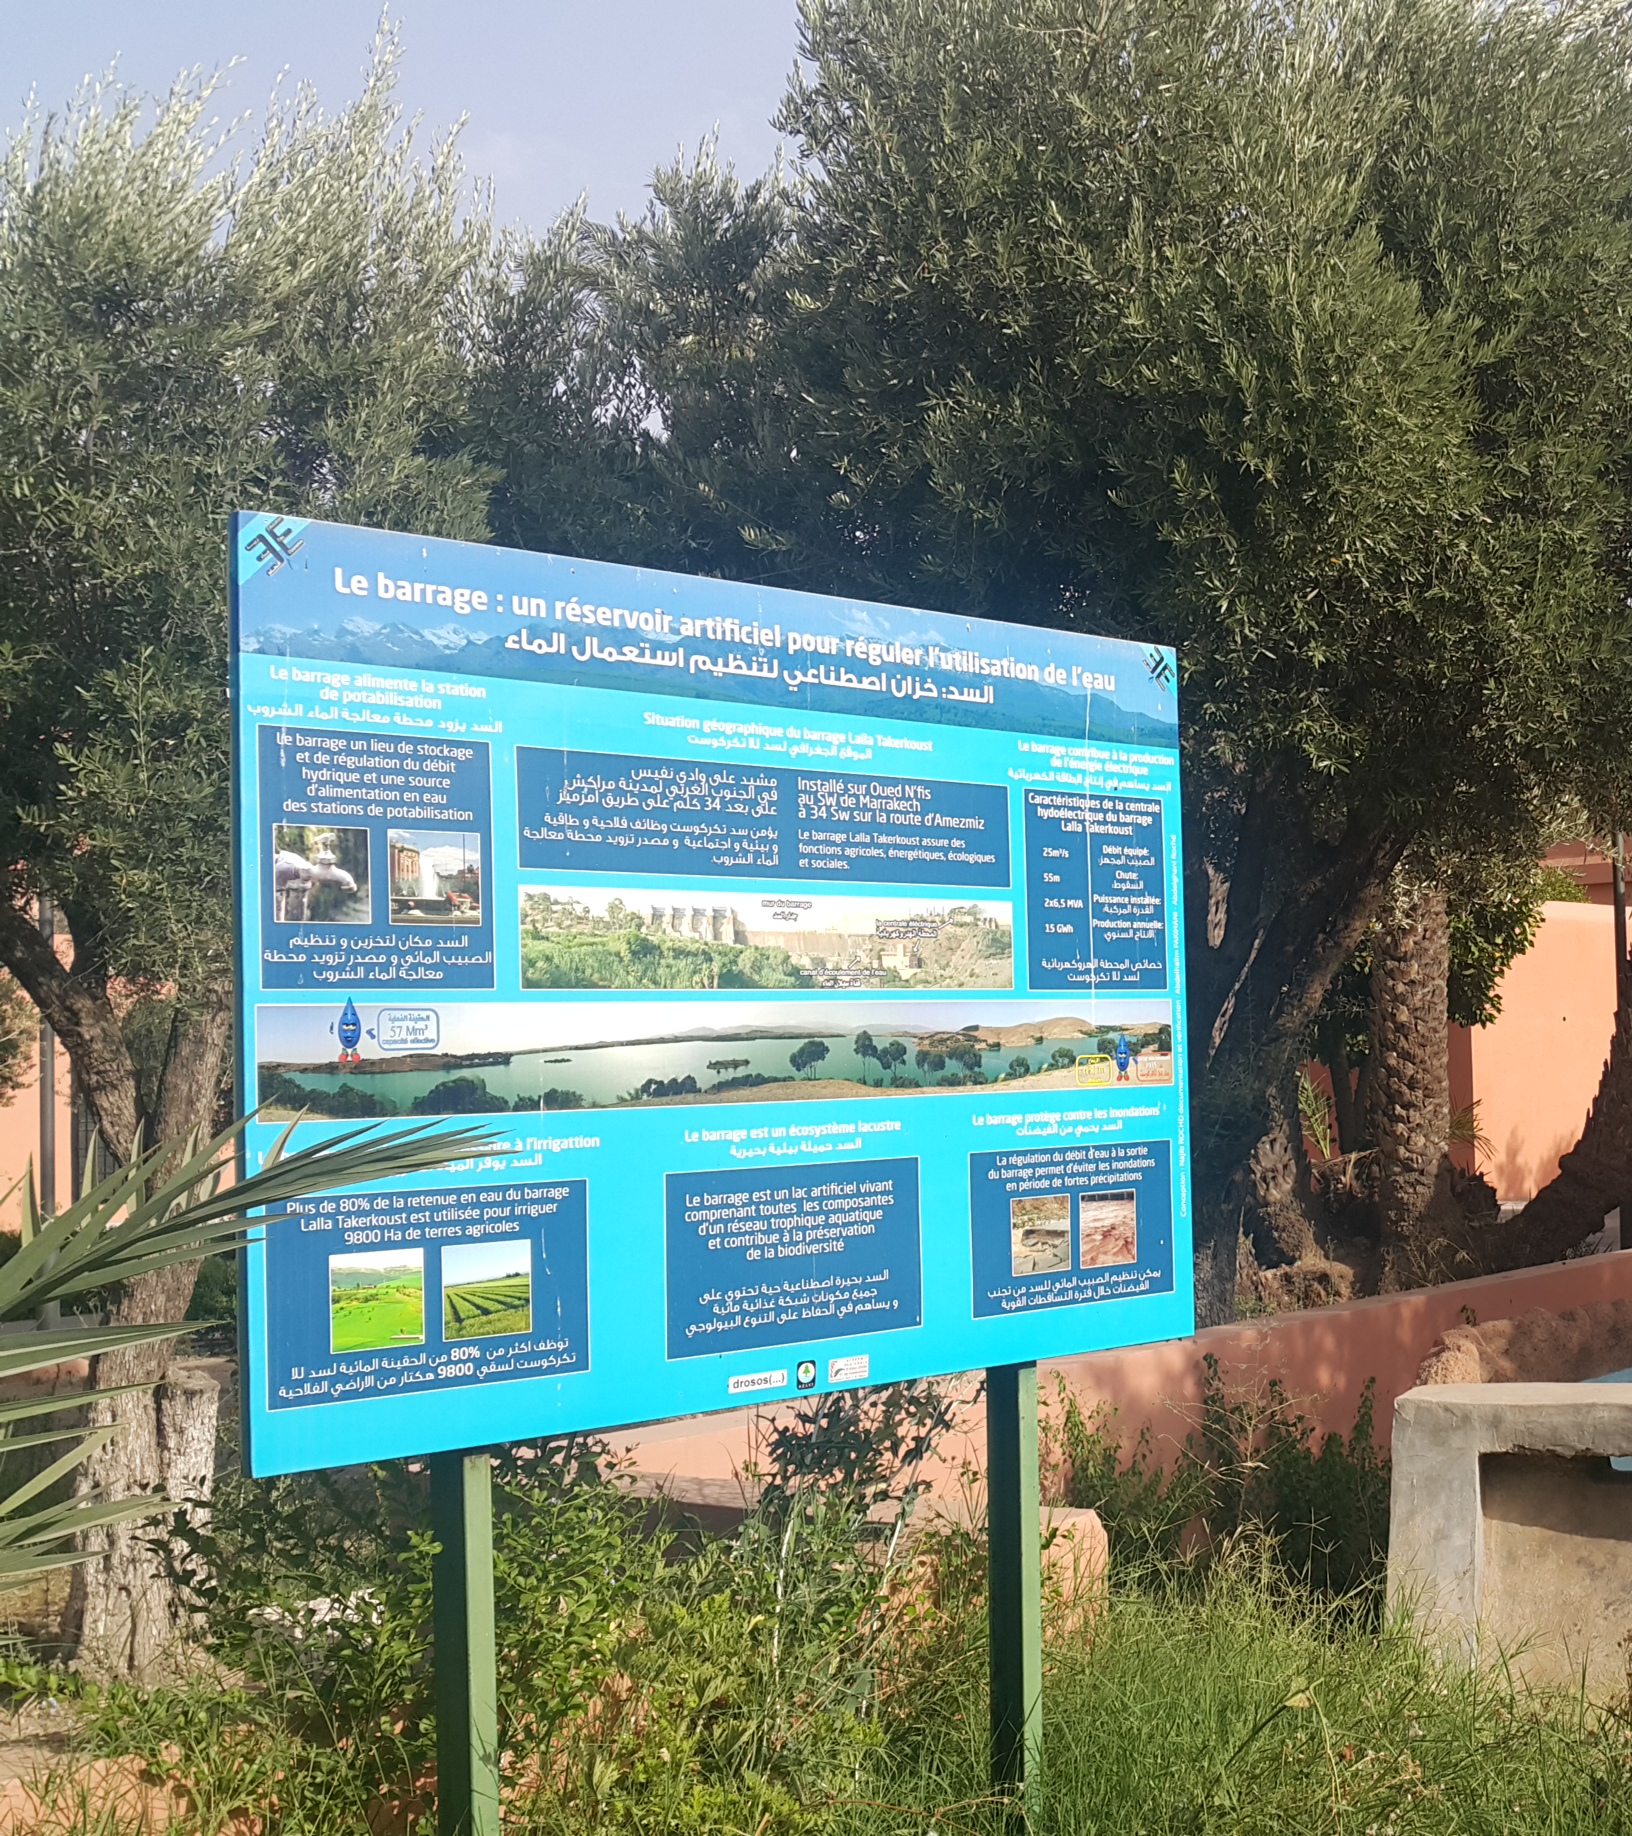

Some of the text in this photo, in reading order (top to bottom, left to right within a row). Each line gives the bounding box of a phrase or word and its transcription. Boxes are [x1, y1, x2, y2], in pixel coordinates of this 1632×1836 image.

[333, 567, 368, 595] Le
[376, 572, 487, 616] barrage
[512, 596, 545, 617] un
[555, 595, 672, 633] réservoir
[679, 613, 780, 647] artificiel
[787, 632, 839, 659] pour
[845, 635, 922, 669] réguler
[928, 646, 1038, 680] l'utilisation
[1043, 662, 1067, 684] de
[1072, 667, 1115, 690] l'eau
[504, 627, 993, 703] السد: خزان اصطناعي لتنظيم استعمال الماء
[270, 665, 487, 699] Le barrage alimente la station
[319, 686, 442, 710] de potabilisation
[644, 712, 933, 752] Situation géographique du barrage Lalla Takerkoust
[276, 731, 474, 761] Le barrage un lieu de stockage
[296, 751, 456, 773] et de régulation du débit
[302, 767, 451, 789] hydrique et une source
[798, 776, 932, 800] Installé sur Oued N'fis
[307, 783, 447, 804] d'alimentation en eau
[798, 792, 921, 812] au SW de Marrakech
[1028, 792, 1161, 814] Caractéristiques de la centrale
[283, 799, 473, 821] des stations de potabilisation
[798, 804, 985, 830] à 34 Sw sur la route d'Amezmiz
[1105, 811, 1118, 823] du
[1119, 811, 1153, 827] barrage
[798, 829, 966, 849] Le barrage Lalla Takerkoust assure des
[1061, 820, 1133, 836] Lalla Takerkoust
[798, 842, 996, 864] fonctions agricoles, énergétiques, écologiques
[799, 858, 850, 870] et sociales.
[1043, 873, 1061, 882] 55m
[1115, 870, 1139, 880] Chute:
[1044, 898, 1084, 909] 2x6,5 MVA
[1045, 923, 1074, 933] 15 GWh
[289, 934, 468, 951] السد مكان لتخزين و تنظيم
[264, 950, 492, 967] الصبيب المائي و مصدر تزويد محطة
[313, 966, 444, 983] معالجة الماء الشروب
[390, 1025, 403, 1038] 57
[684, 1120, 902, 1143] Le barrage est un écosystème lacustre
[686, 1179, 893, 1208] Le barrage est un lac artificiel vivant
[1006, 1172, 1143, 1193] en période de fortes précipitations
[301, 1202, 558, 1232] Lalla Takerkoust est utilisée pour irriguer
[685, 1194, 895, 1222] comprenant toutes les composantes
[344, 1220, 520, 1245] 9800 Ha de terres agricoles
[733, 1372, 785, 1389] drosos(...)
